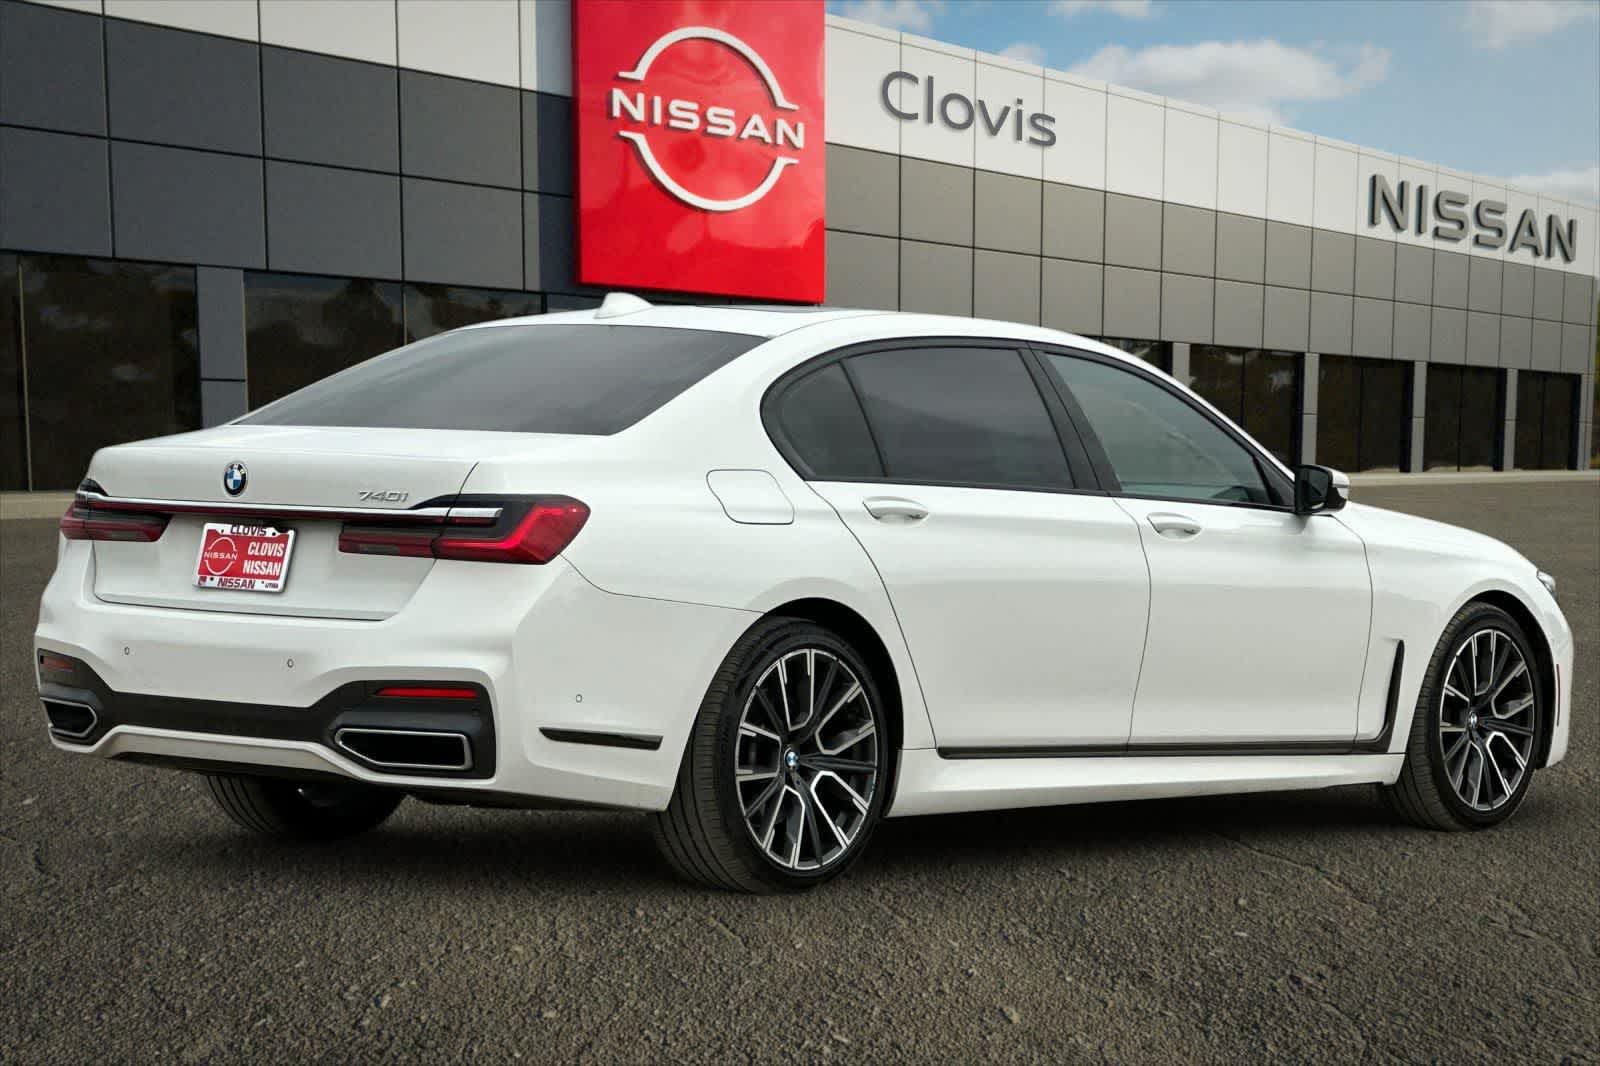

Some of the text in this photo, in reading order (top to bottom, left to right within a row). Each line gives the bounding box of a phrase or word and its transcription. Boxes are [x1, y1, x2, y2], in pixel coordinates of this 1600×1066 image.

[881, 70, 1057, 147] Clovis
[610, 88, 805, 149] NISSAN
[1368, 173, 1578, 263] NISSAN
[230, 525, 266, 536] CLOVIS
[203, 551, 238, 560] NISSAN
[247, 541, 285, 557] CLOVIS
[242, 560, 281, 575] NISSAN
[217, 578, 256, 589] NISSAN
